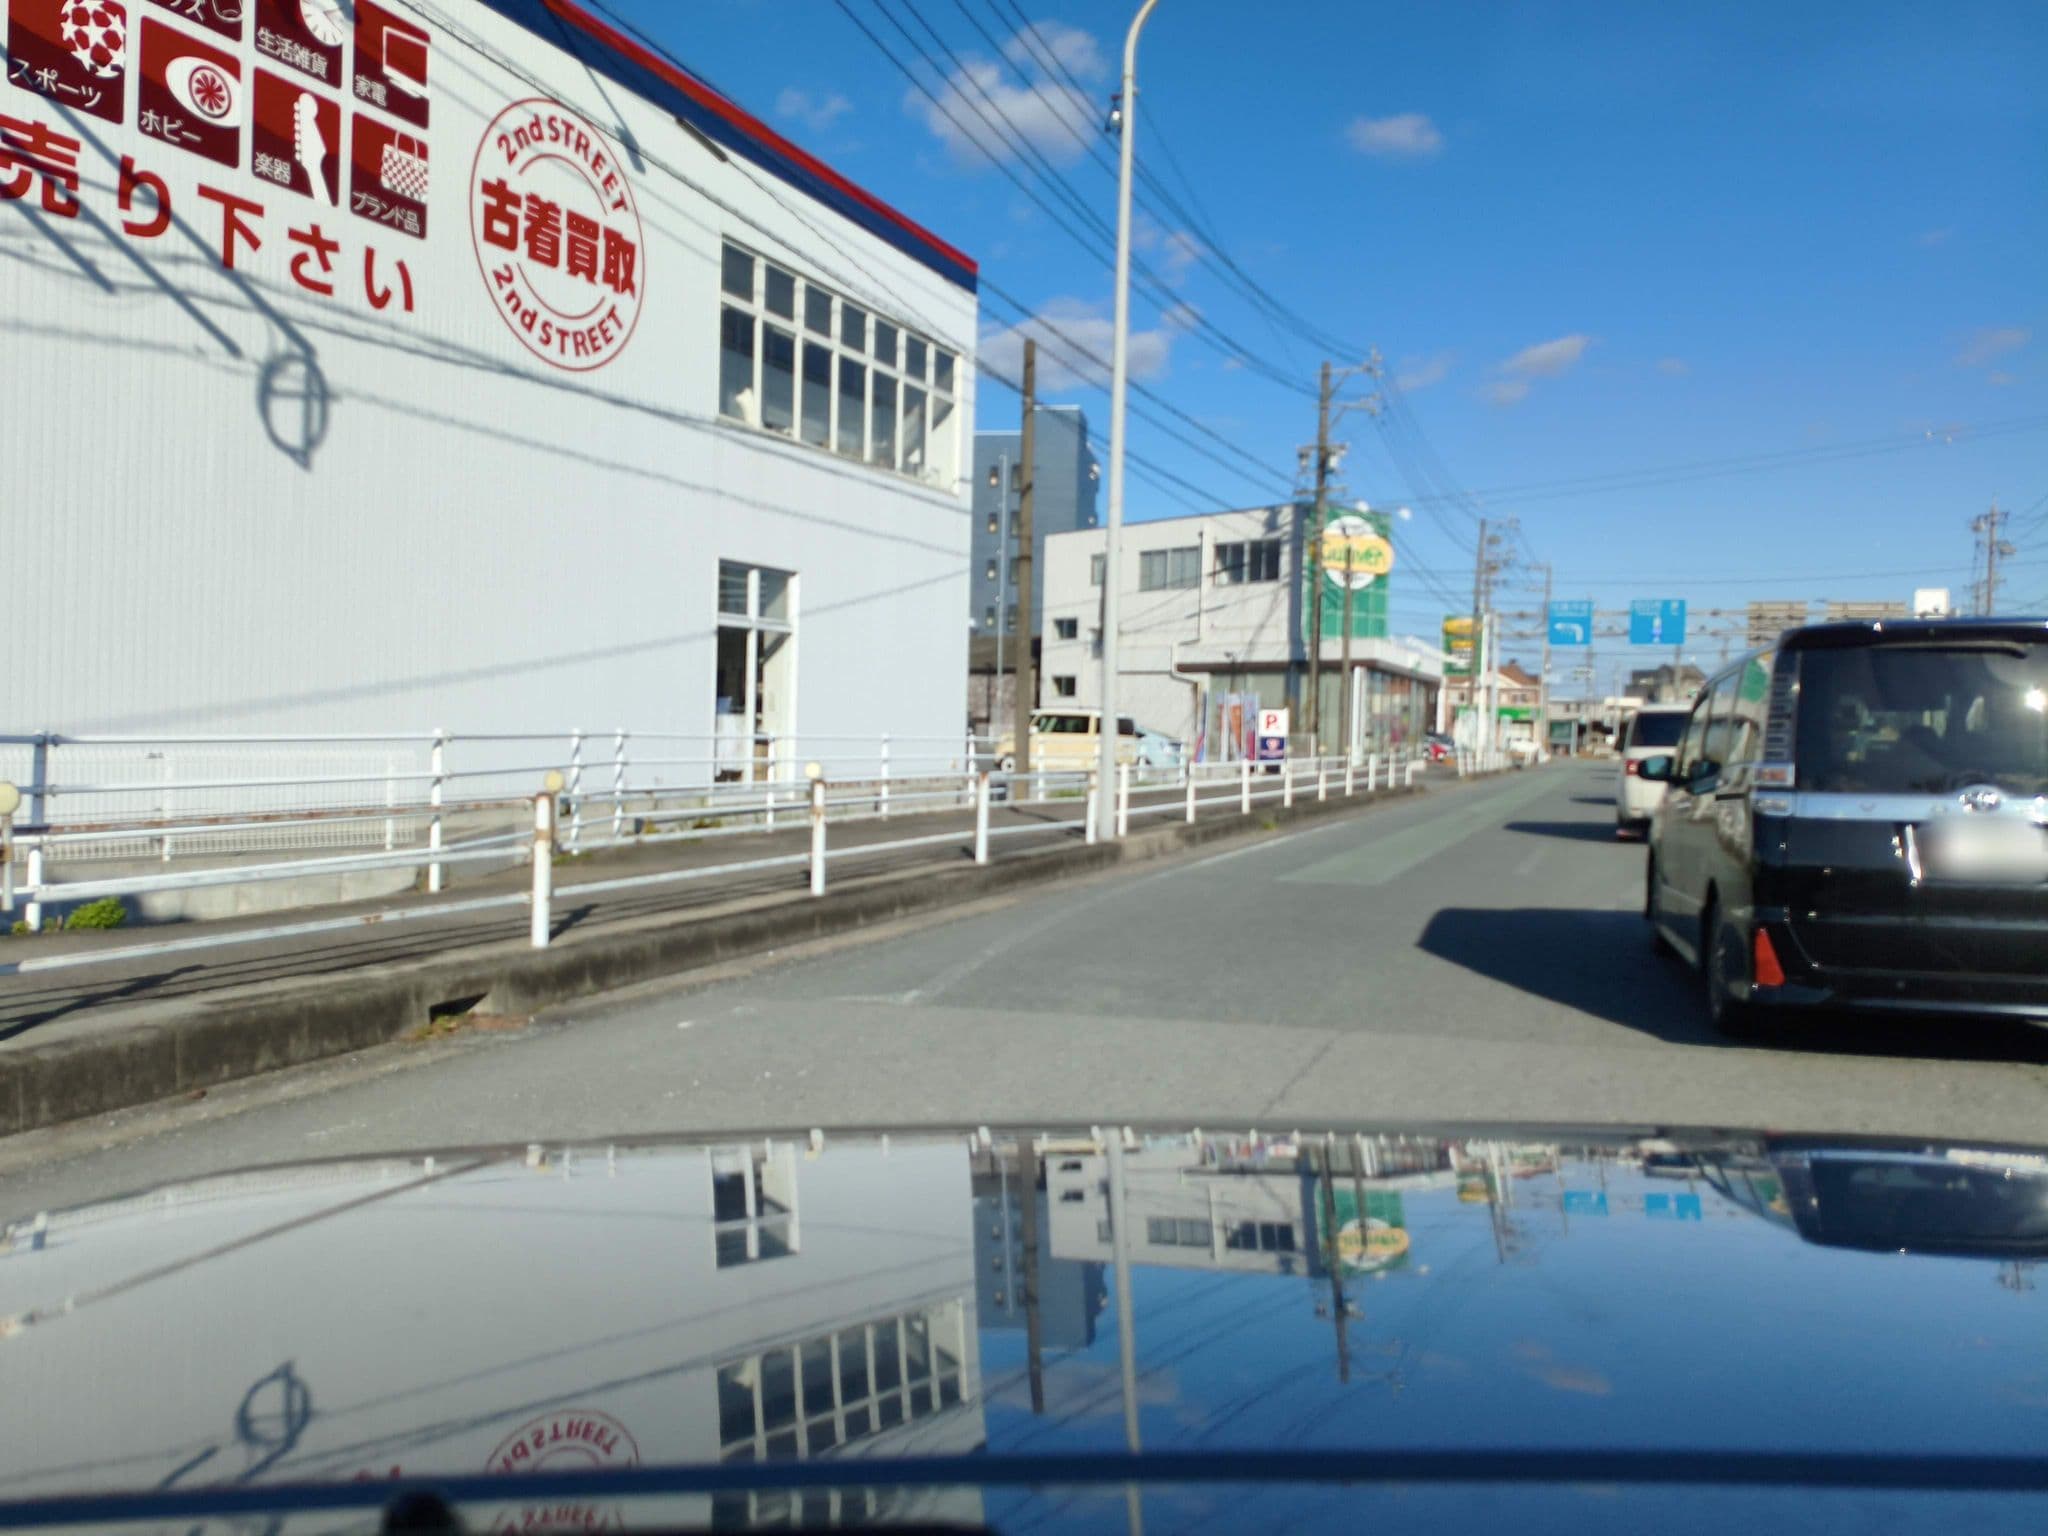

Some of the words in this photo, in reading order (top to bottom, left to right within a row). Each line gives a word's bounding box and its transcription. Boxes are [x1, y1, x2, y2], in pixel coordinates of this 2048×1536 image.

[256, 26, 328, 80] 生活雑貨
[10, 57, 102, 108] スポーツ
[354, 73, 387, 107] 家電
[140, 108, 202, 142] ホビー
[255, 152, 291, 185] 楽器
[497, 113, 544, 166] 2nd
[549, 115, 628, 214] STREET
[352, 191, 420, 234] ブランド品
[481, 176, 636, 300] 古着買取
[492, 263, 538, 333] 2nd
[538, 304, 624, 358] STREET
